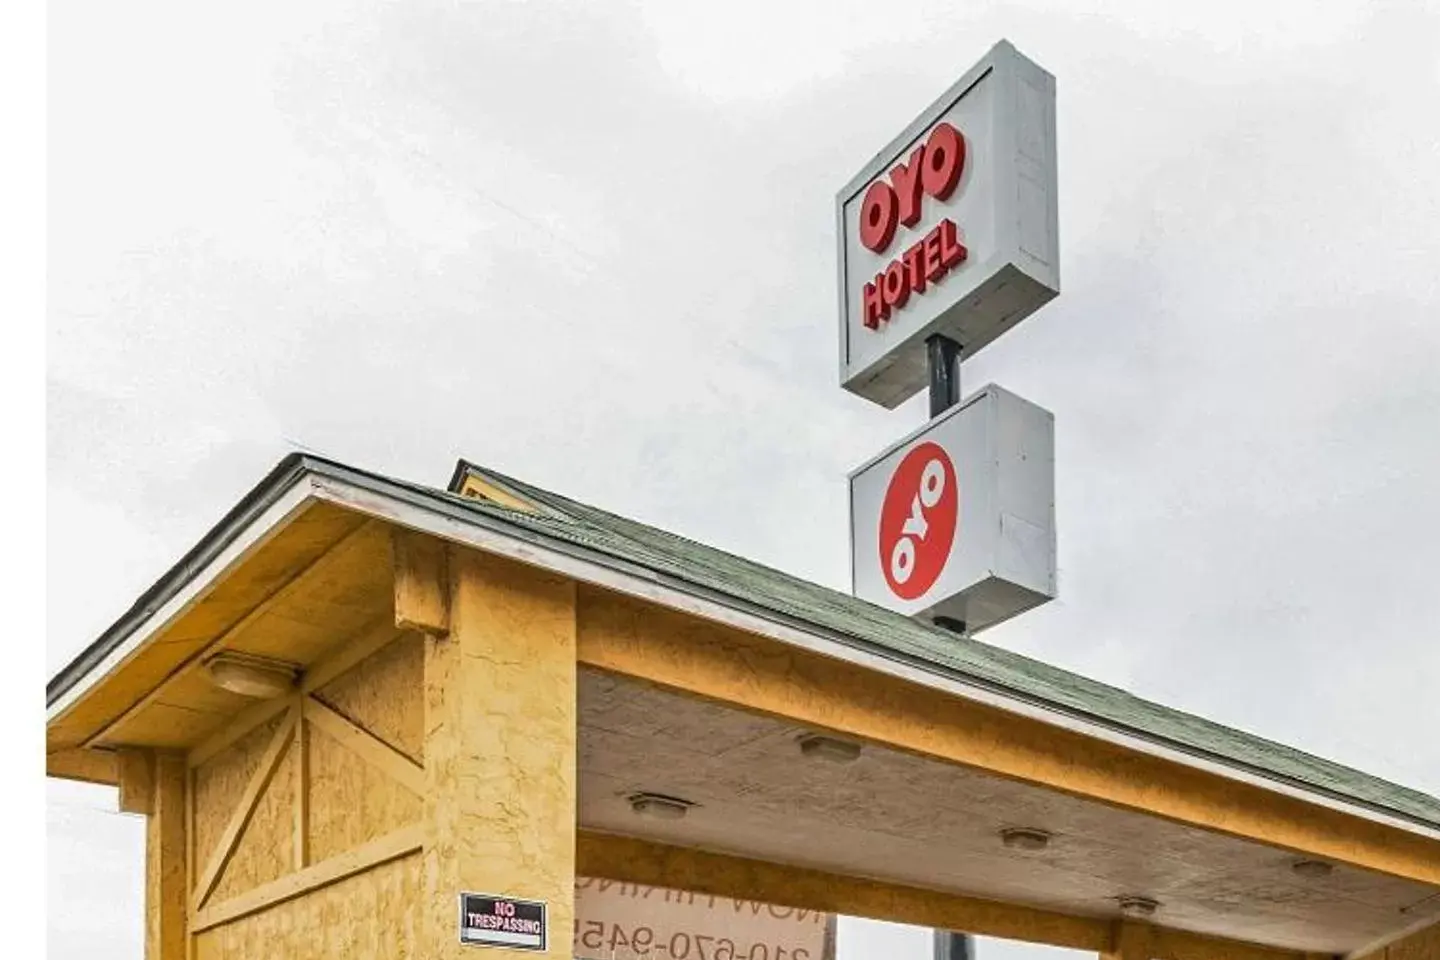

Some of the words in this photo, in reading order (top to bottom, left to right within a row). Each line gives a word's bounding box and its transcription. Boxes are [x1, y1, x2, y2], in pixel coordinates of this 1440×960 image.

[860, 122, 966, 255] OYO
[863, 218, 968, 330] HOTEL
[891, 458, 946, 585] OYO
[468, 912, 540, 934] TRESPASSING
[494, 901, 516, 917] NO
